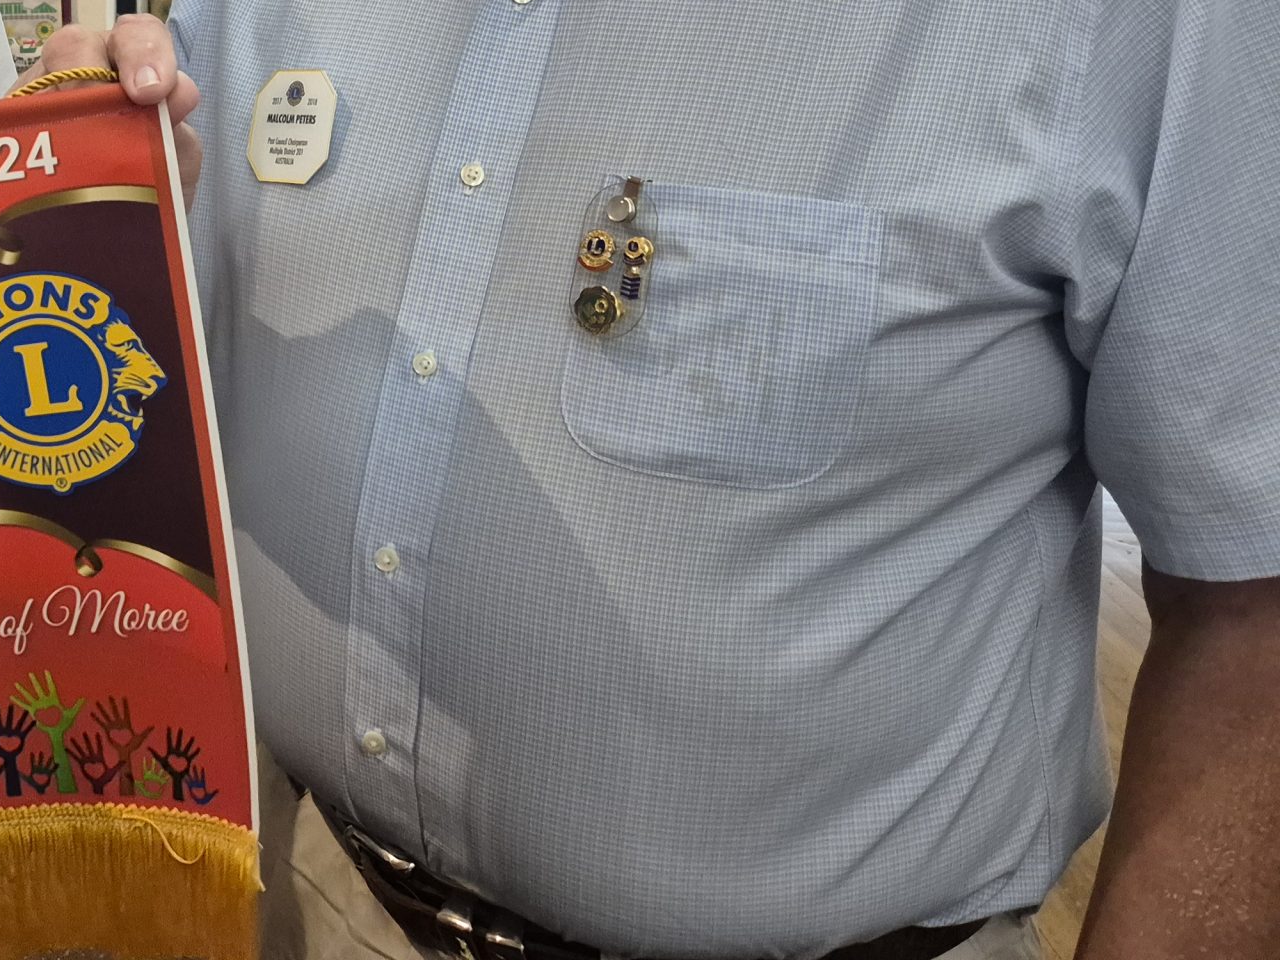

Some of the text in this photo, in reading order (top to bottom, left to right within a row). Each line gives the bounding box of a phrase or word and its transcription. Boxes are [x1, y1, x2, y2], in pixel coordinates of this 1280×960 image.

[267, 114, 316, 124] MALCOLM PETERS
[13, 341, 84, 418] L
[42, 585, 189, 638] Moree
